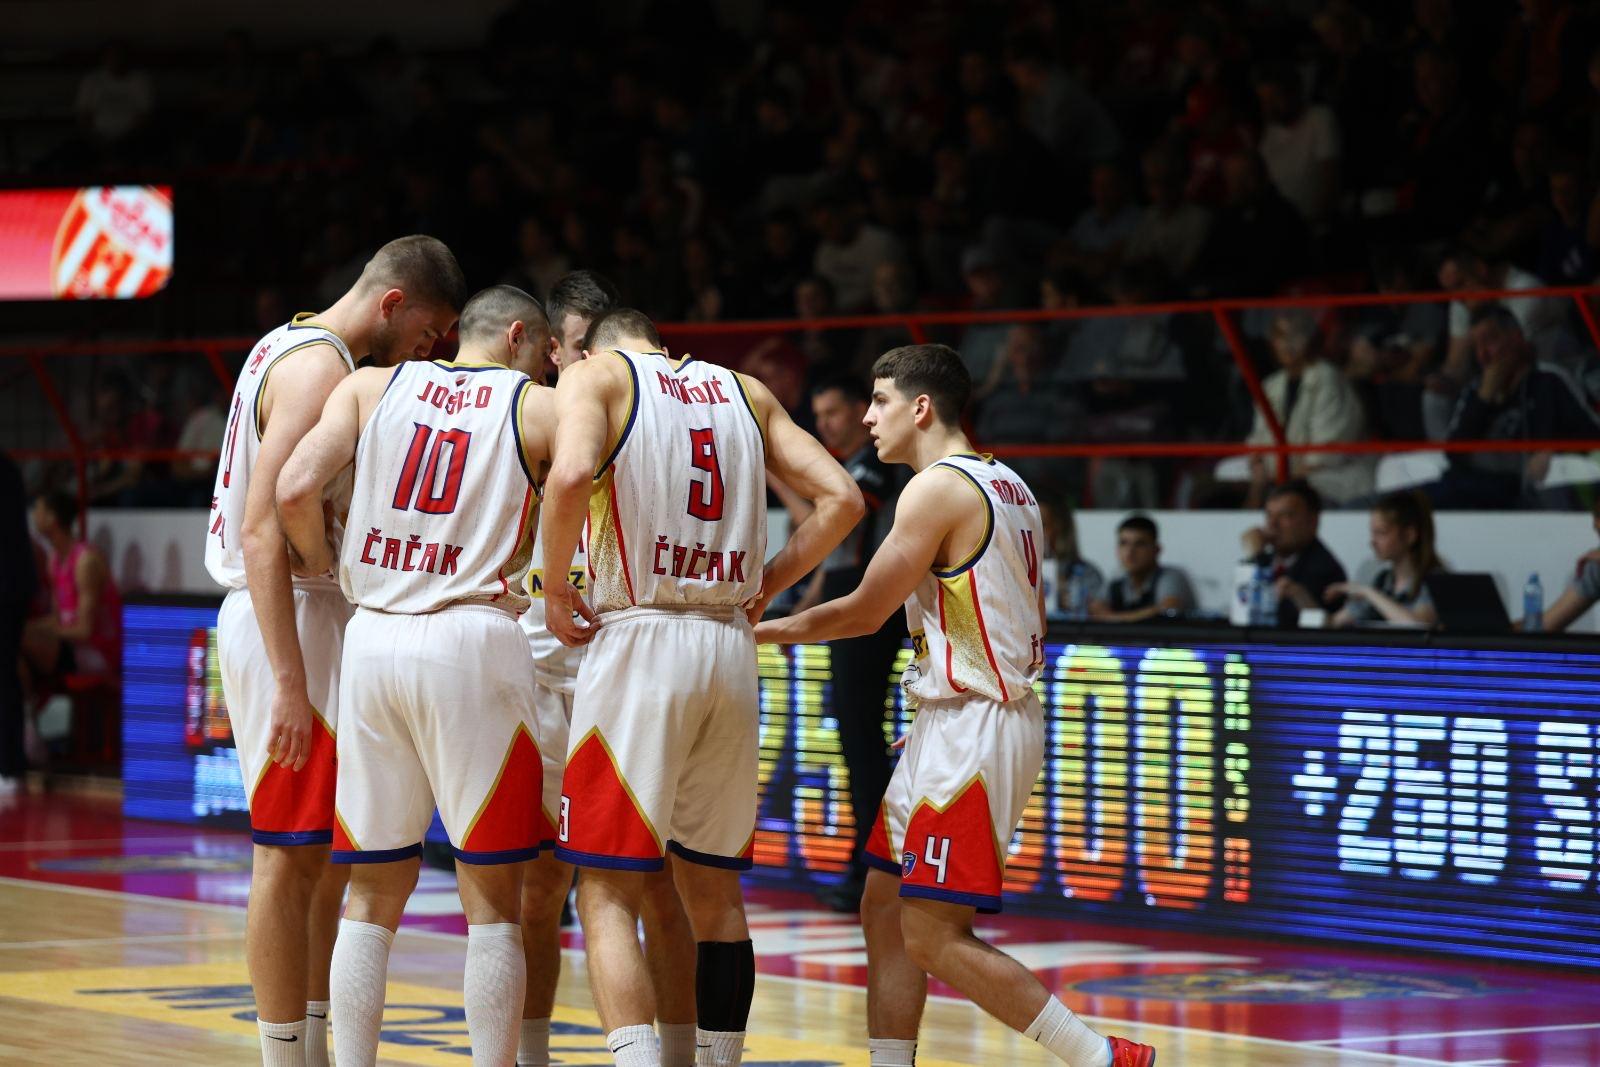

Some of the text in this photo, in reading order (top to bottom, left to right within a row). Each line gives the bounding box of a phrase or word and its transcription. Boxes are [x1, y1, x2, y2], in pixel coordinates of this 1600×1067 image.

[392, 421, 472, 515] 10
[687, 427, 725, 522] 9
[359, 527, 464, 576] ČAČAK
[652, 534, 747, 583] ČAČAK
[924, 834, 951, 884] 4
